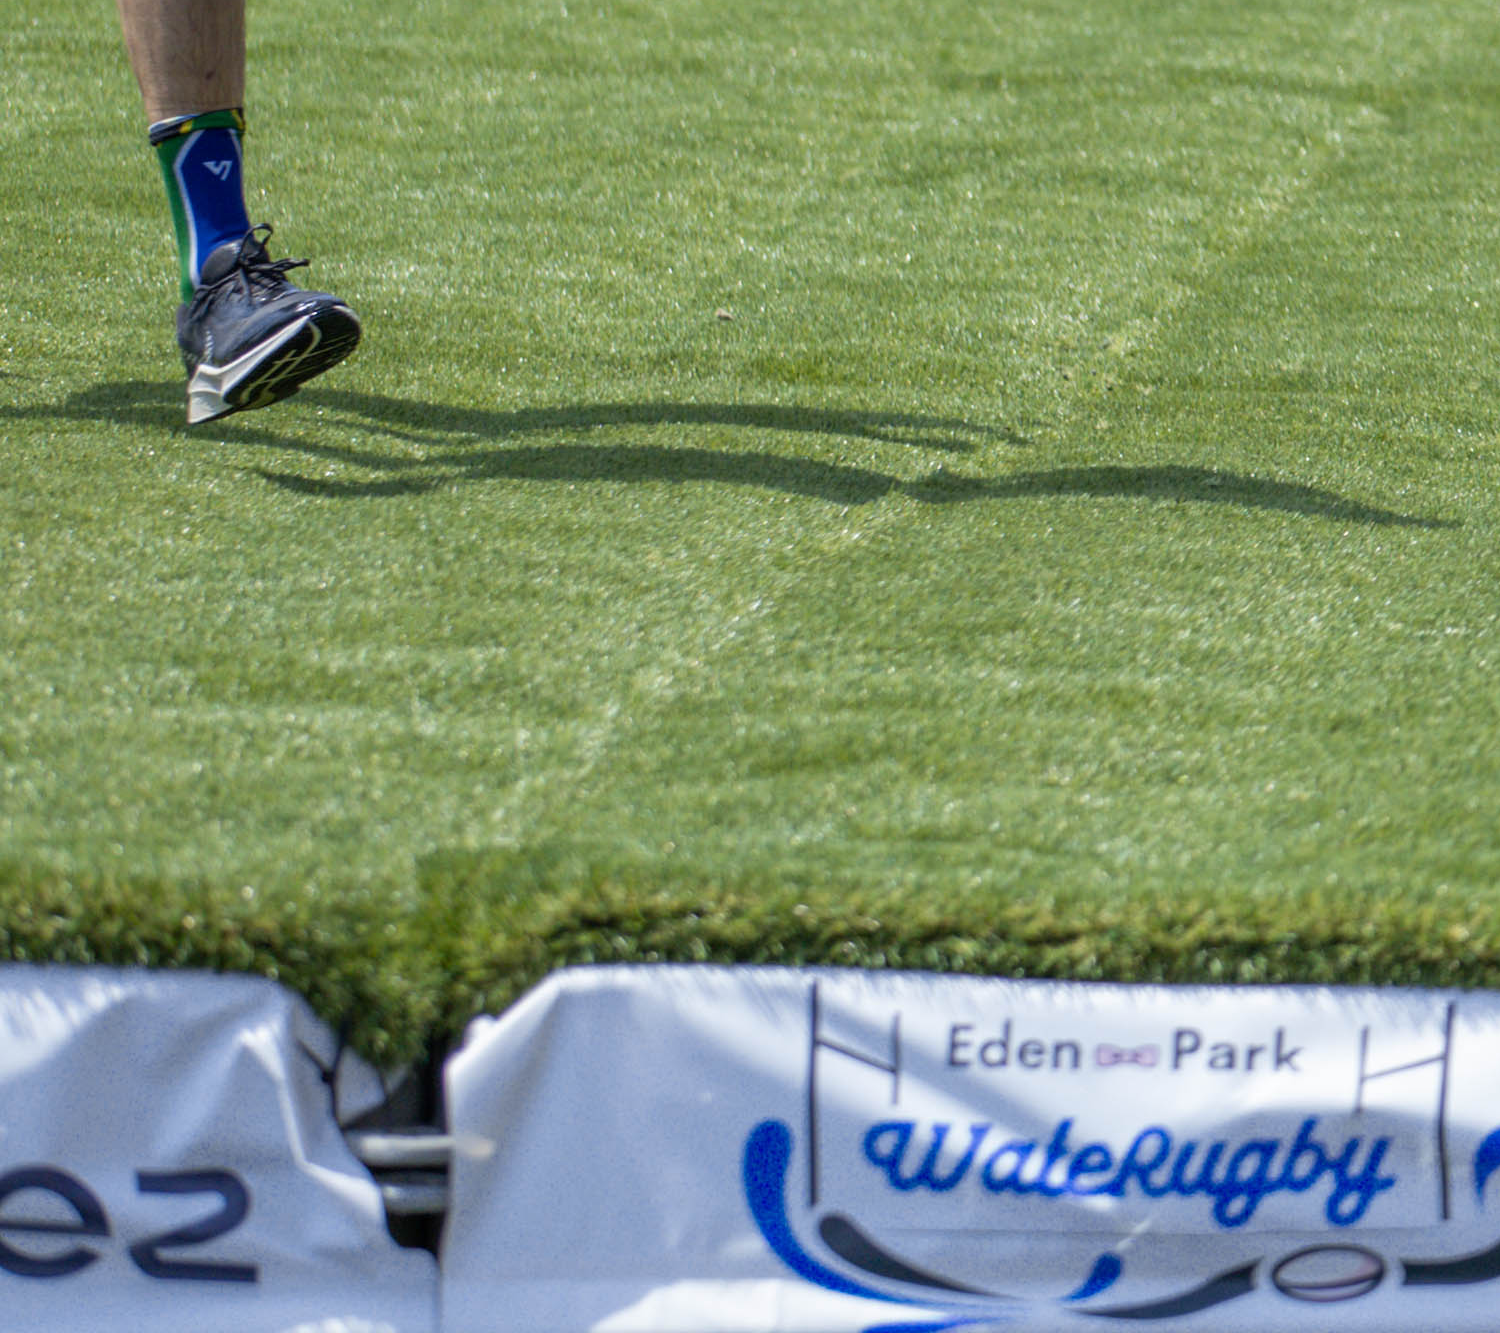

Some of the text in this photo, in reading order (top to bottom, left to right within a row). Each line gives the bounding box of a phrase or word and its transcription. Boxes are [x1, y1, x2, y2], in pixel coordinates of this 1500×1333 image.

[946, 1019, 1308, 1073] Eden Park
[863, 1117, 1397, 1228] WateRugby
